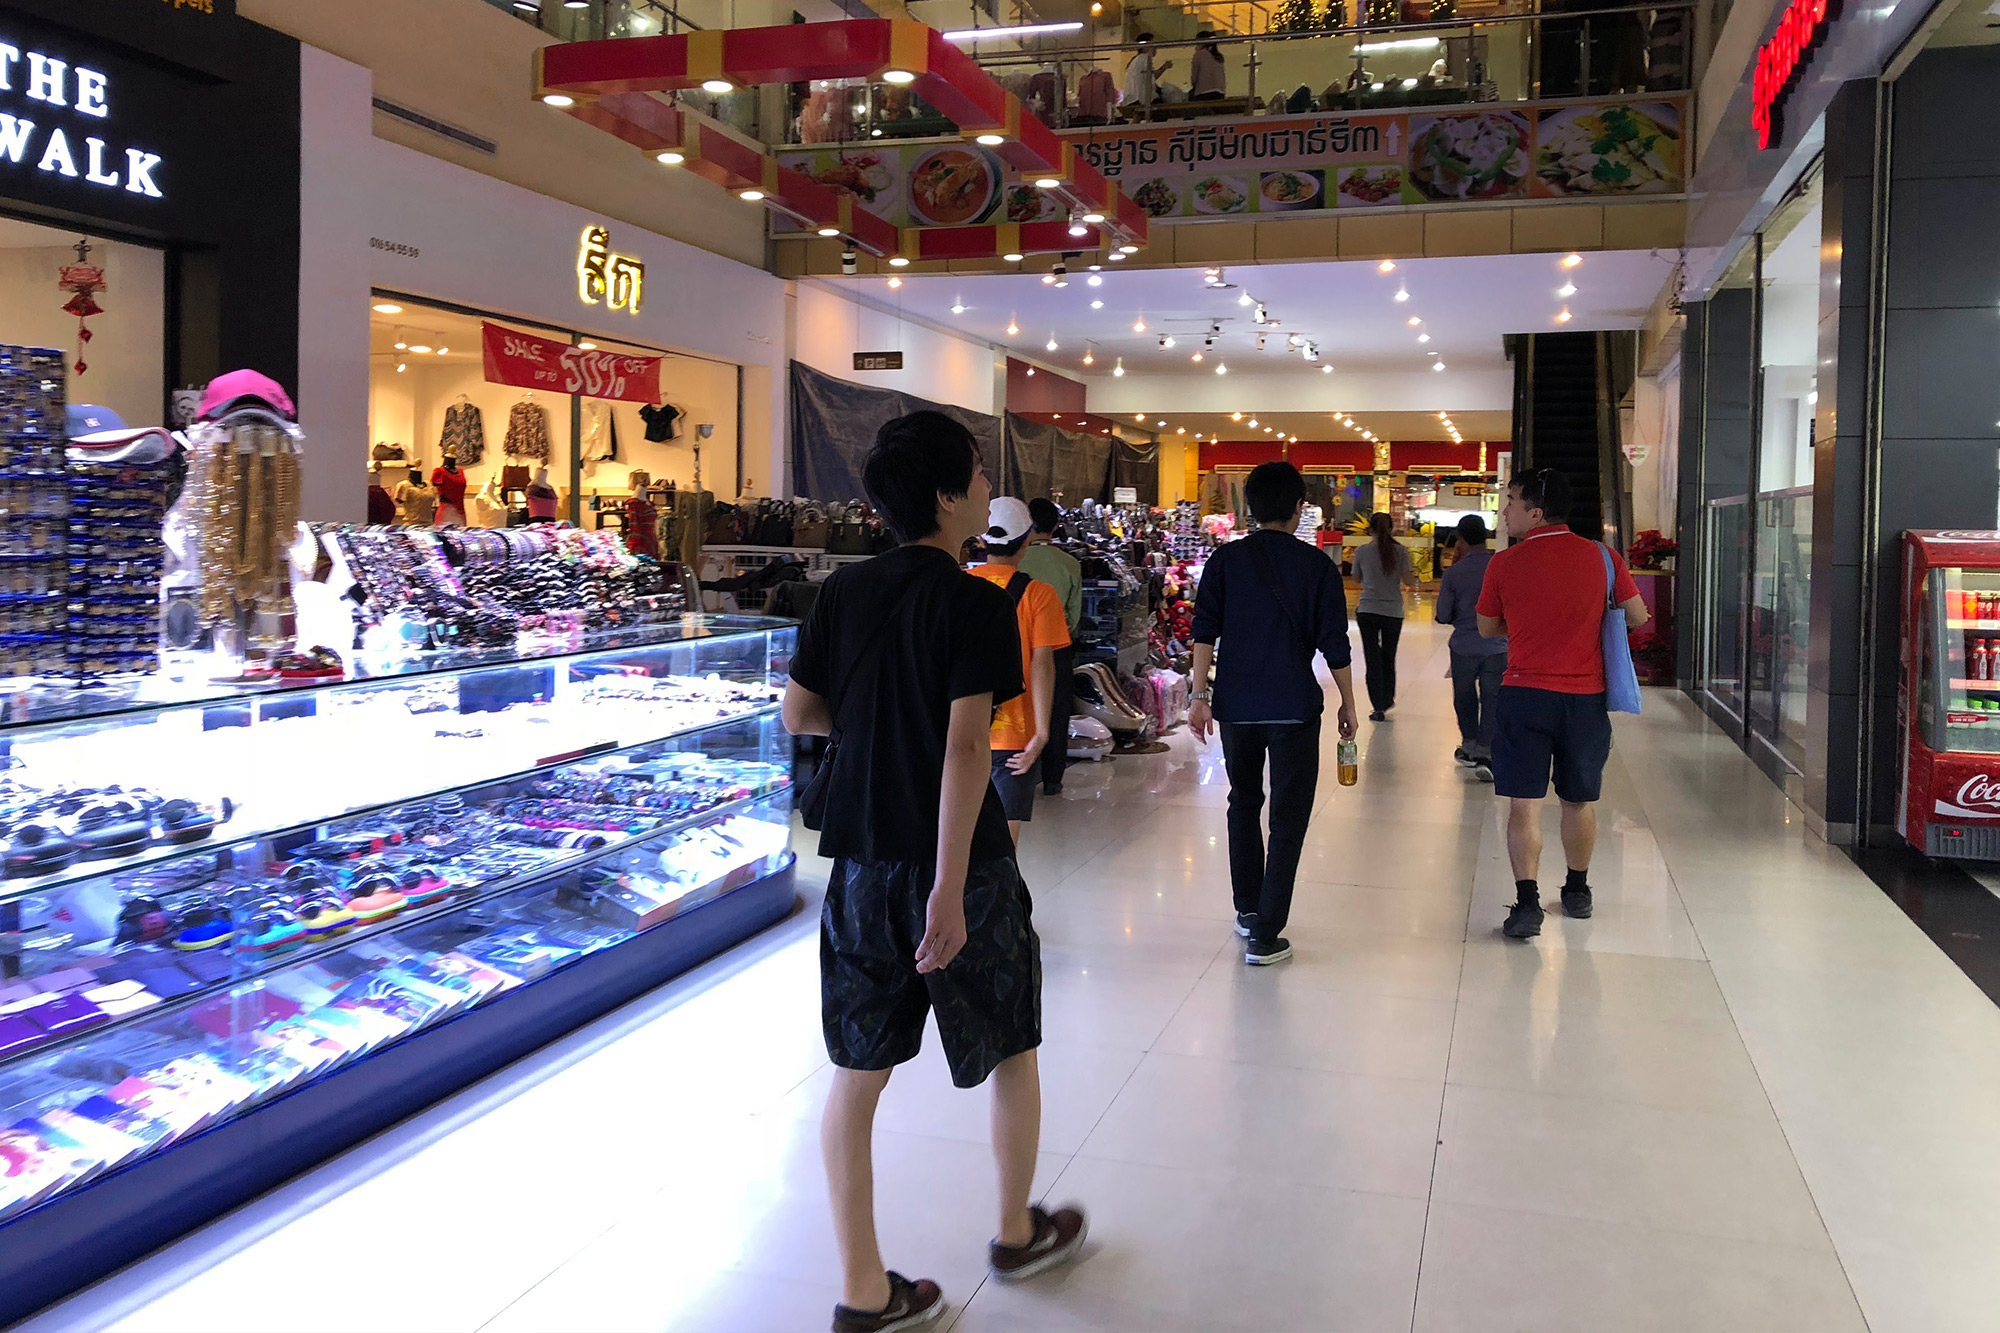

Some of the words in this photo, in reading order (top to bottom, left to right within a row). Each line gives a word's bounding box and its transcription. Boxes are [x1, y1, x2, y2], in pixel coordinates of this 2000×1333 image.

[0, 42, 108, 118] THE
[0, 112, 163, 198] WALK
[504, 335, 545, 362] SALE
[560, 346, 626, 398] 50%
[623, 359, 650, 375] OFF
[1956, 774, 2000, 808] Coc
